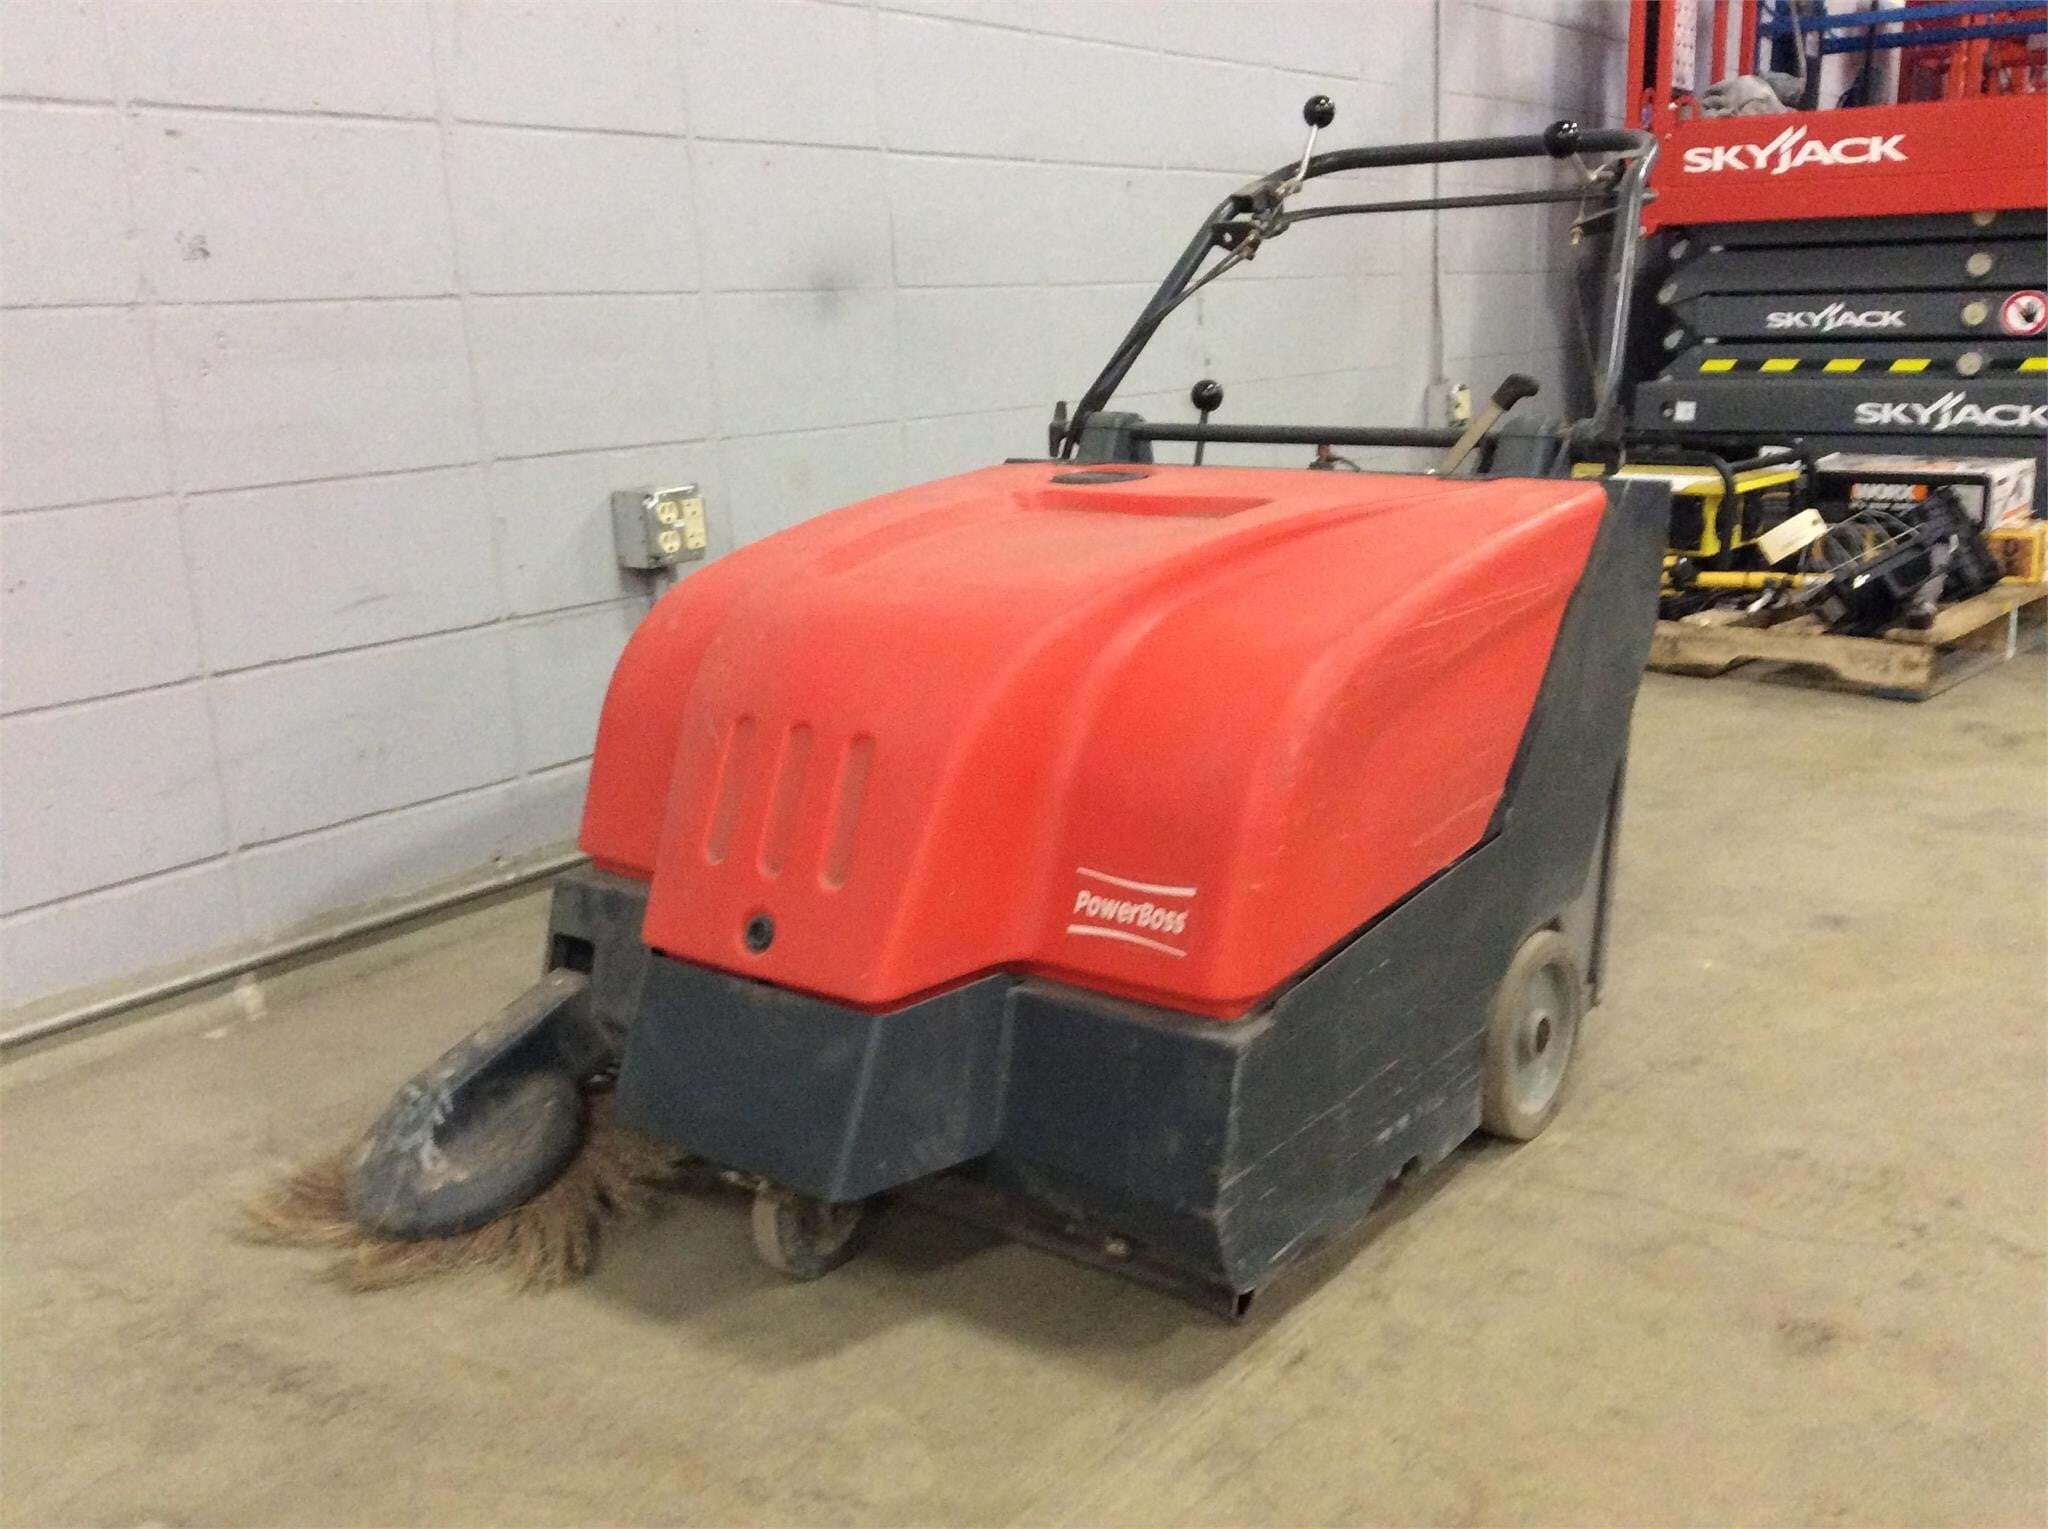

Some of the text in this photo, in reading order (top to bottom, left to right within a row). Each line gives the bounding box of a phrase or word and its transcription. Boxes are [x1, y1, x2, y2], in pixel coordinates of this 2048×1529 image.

[1683, 125, 1908, 175] SKYJACK
[1766, 303, 1906, 332] SKYJACK
[1854, 392, 2048, 431] SKYJACK
[1074, 890, 1188, 934] PowerBoss
